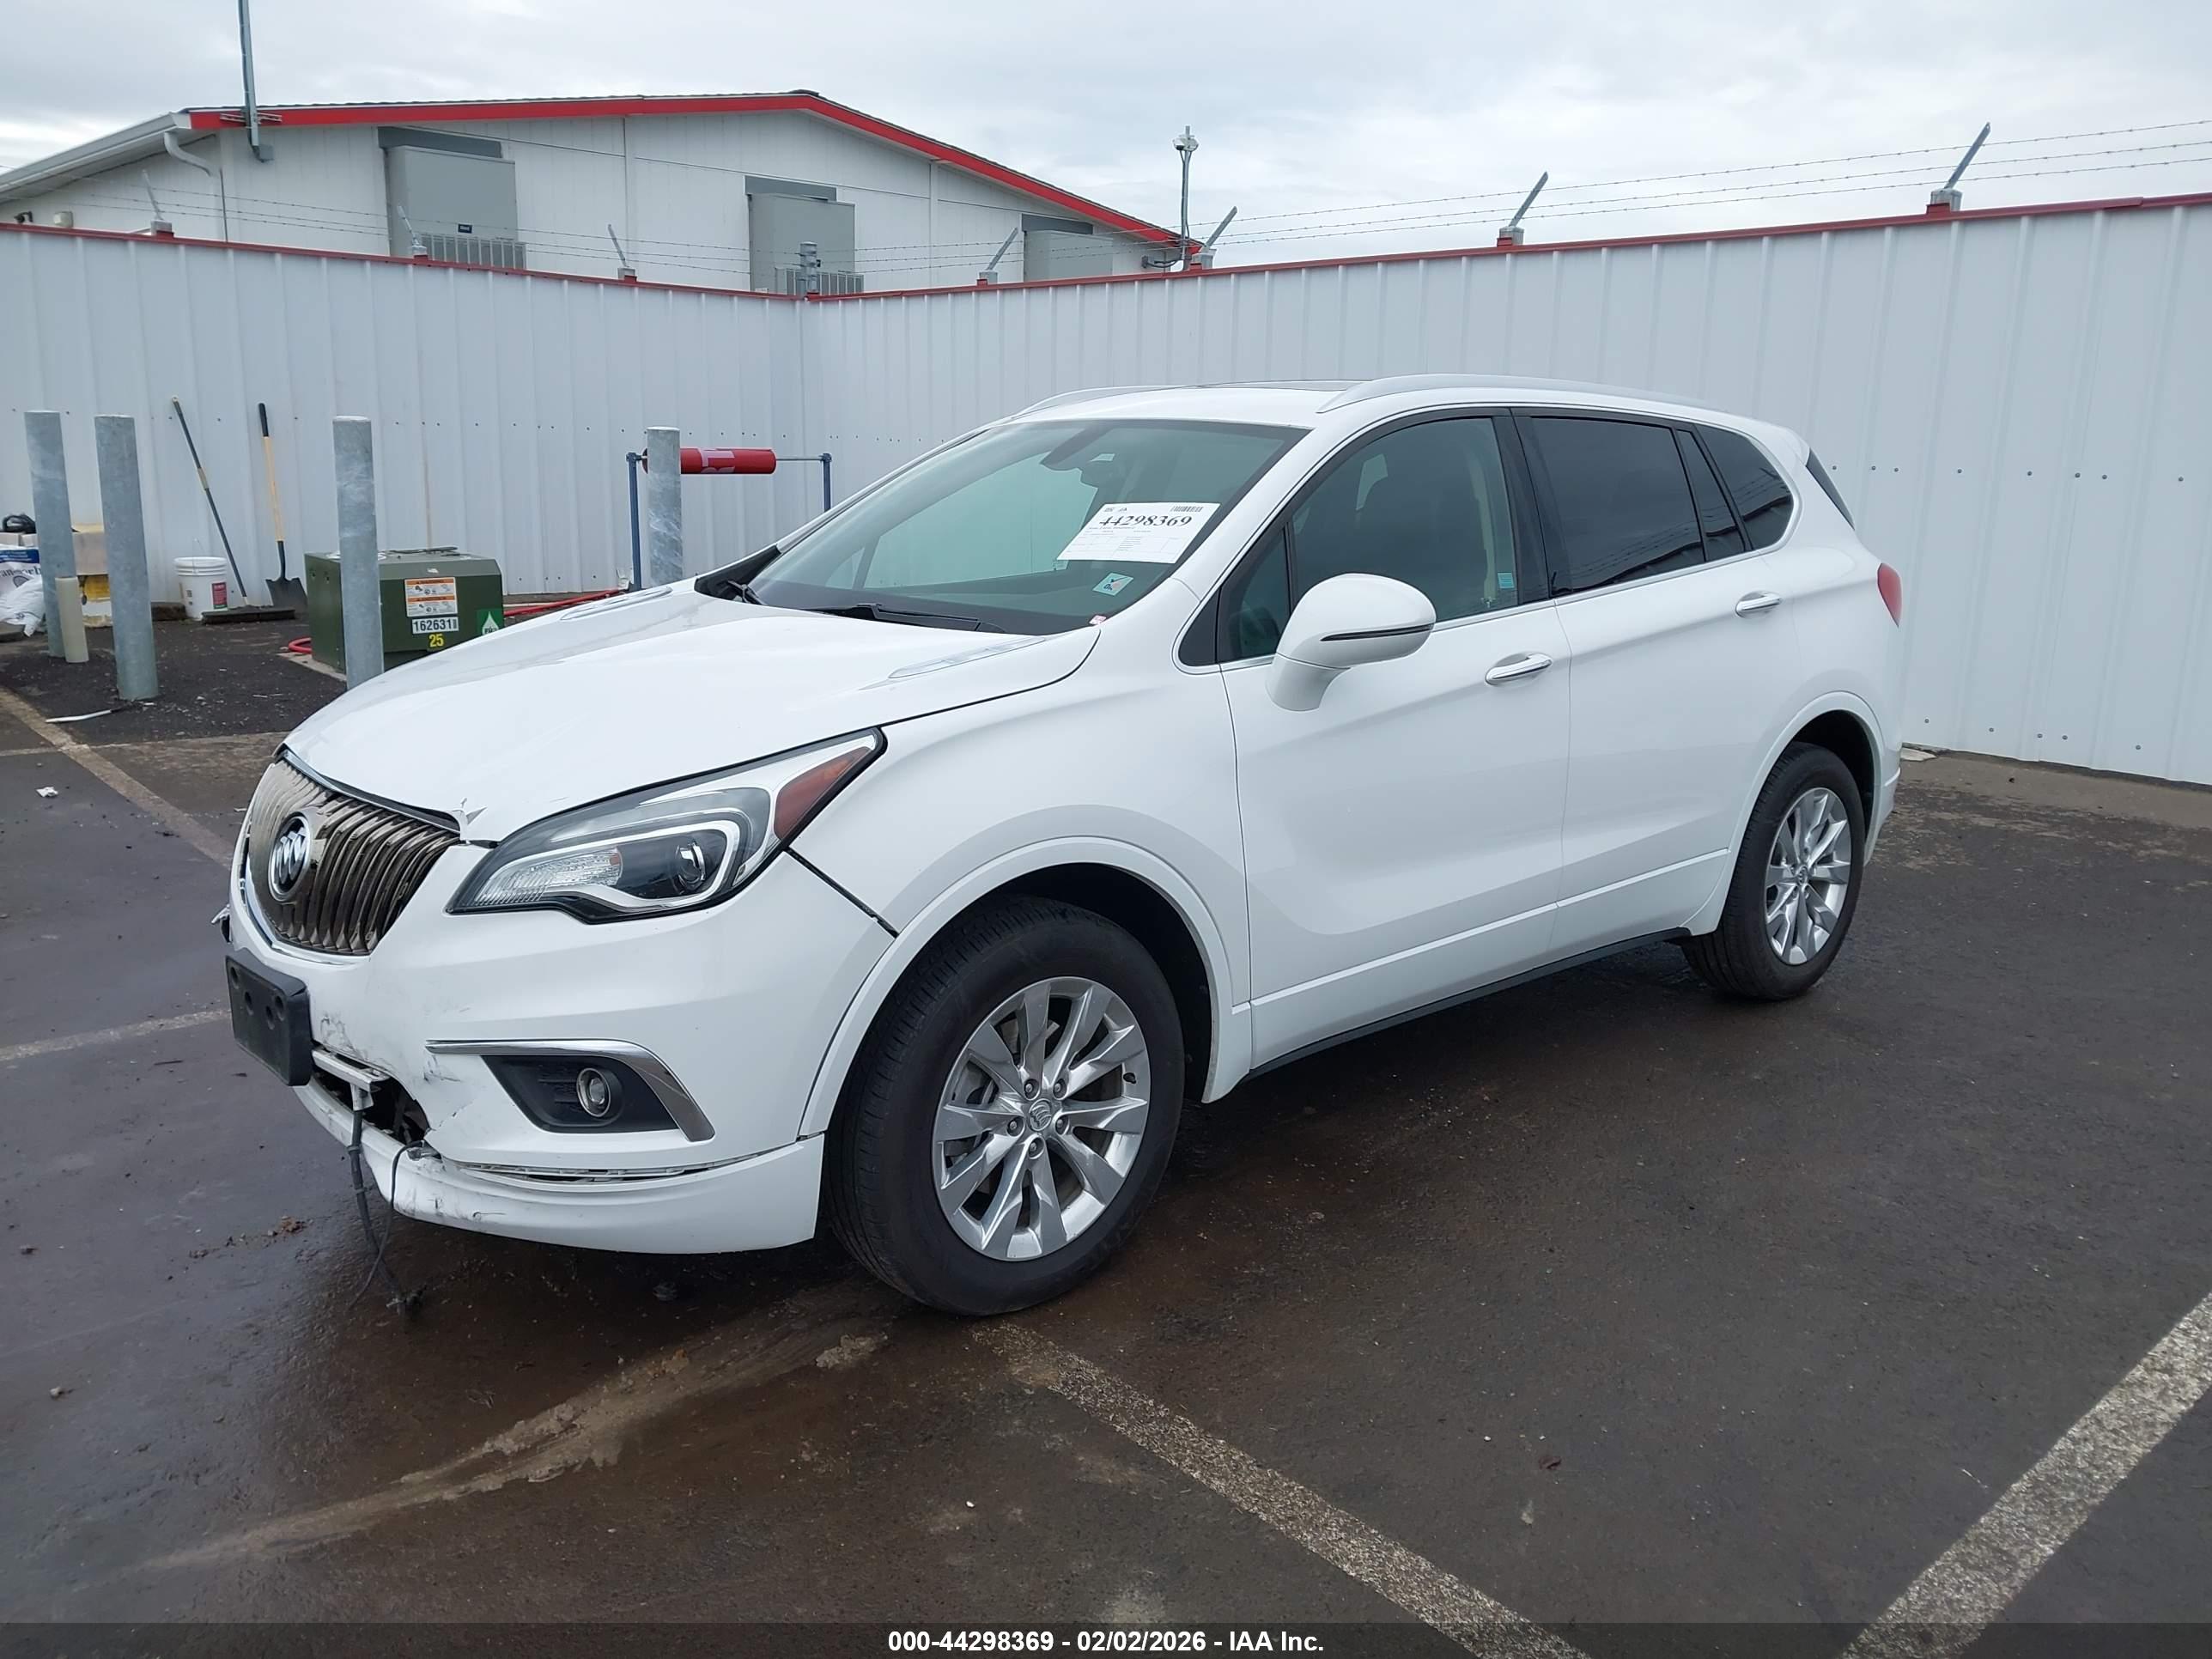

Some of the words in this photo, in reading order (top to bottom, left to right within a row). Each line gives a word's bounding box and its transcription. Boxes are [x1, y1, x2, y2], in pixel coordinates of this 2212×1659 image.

[1099, 515, 1193, 526] 44298369
[413, 618, 452, 632] 162631
[428, 633, 444, 647] 25
